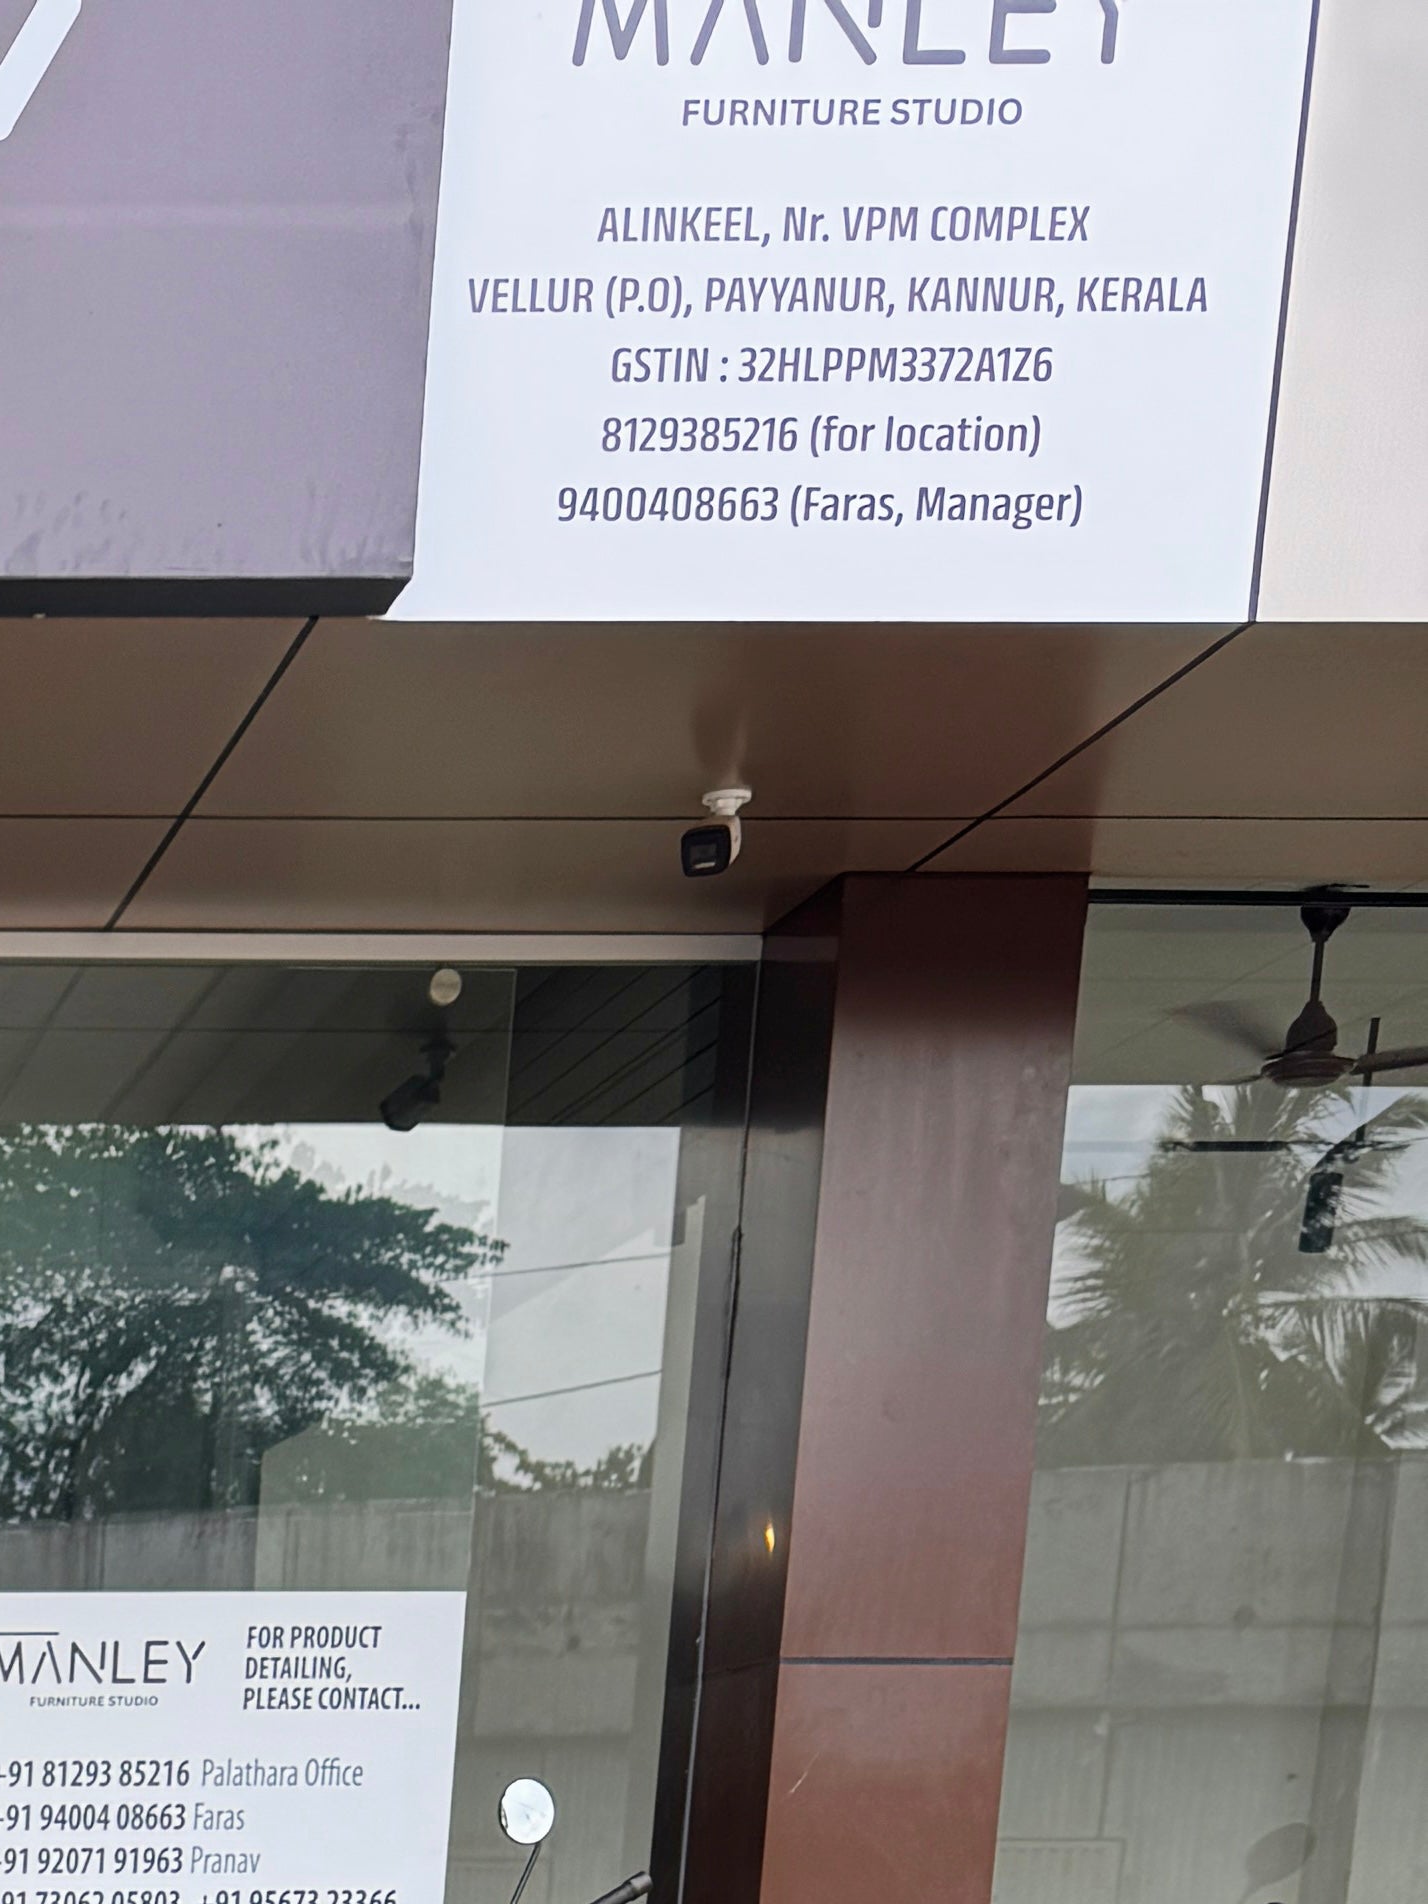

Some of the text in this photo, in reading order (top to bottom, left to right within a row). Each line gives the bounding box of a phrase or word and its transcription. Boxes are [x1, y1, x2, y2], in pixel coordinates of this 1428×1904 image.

[682, 97, 1023, 127] FURNITURE STUDIO
[597, 205, 1091, 248] ALINKEEL, Nr. VPM COMPLEX
[468, 275, 1208, 319] VELLUR (P.O), PAYYANUR, KANNUR, KERALA
[611, 347, 709, 383] GSTIN
[738, 346, 1053, 383] 32HLPPM3372A1Z6
[601, 414, 1041, 458] 8129385216 (for location)
[558, 484, 1083, 530] 9400408663 (Faras, Manager)
[246, 1625, 383, 1650] FOR PRODUCT
[245, 1656, 353, 1683] DETAILING,
[29, 1695, 159, 1708] FURNITURE STUDIO
[242, 1686, 421, 1711] PLEASE CONTACT...
[41, 1760, 112, 1788] 81293
[118, 1759, 190, 1787] 85216
[201, 1758, 298, 1787] Palathara
[305, 1757, 364, 1787] Office
[40, 1803, 111, 1831] 94004
[116, 1803, 186, 1831] 08663
[193, 1802, 245, 1831] Faras
[37, 1847, 105, 1875] 92071
[114, 1846, 183, 1874] 91963
[190, 1846, 261, 1874] Pranav
